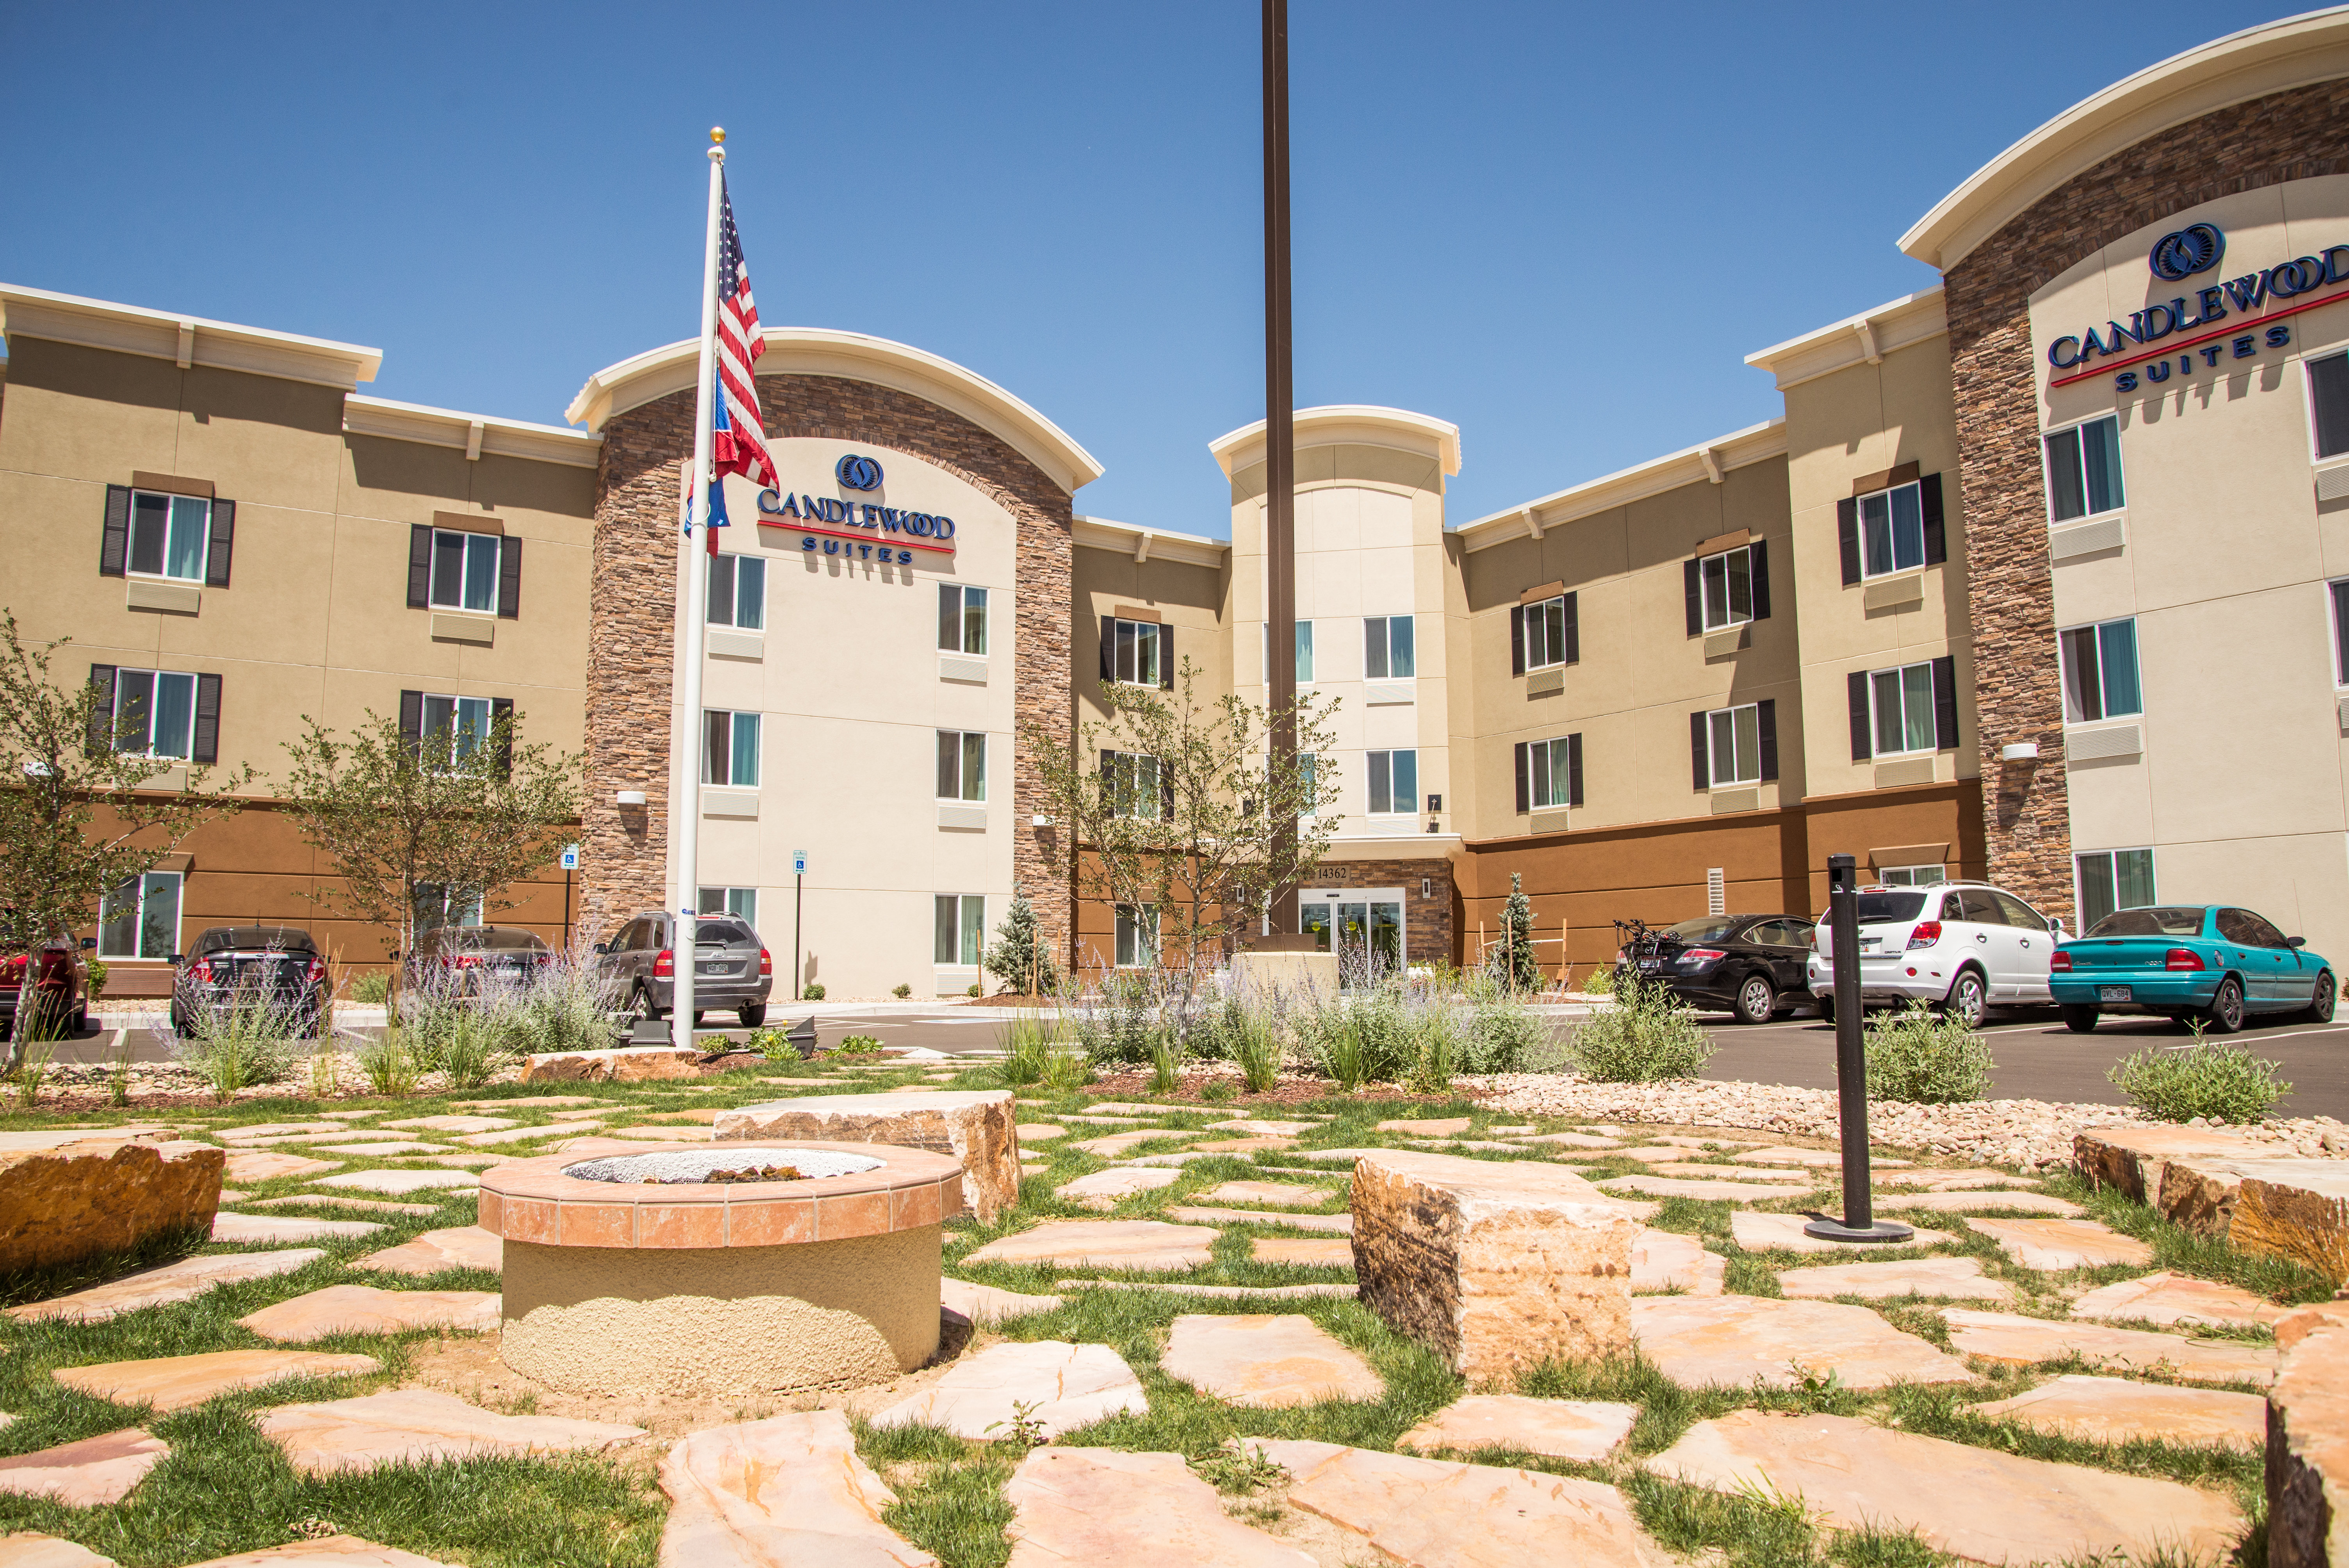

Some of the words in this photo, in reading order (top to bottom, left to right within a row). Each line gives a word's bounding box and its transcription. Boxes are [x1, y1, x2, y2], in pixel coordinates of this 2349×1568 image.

[2048, 244, 2349, 369] CANDLEWOOD
[2115, 326, 2290, 392] SUITES
[757, 488, 955, 540] CANDLEWOOD
[802, 537, 913, 565] SUITES
[1318, 868, 1346, 879] 14362
